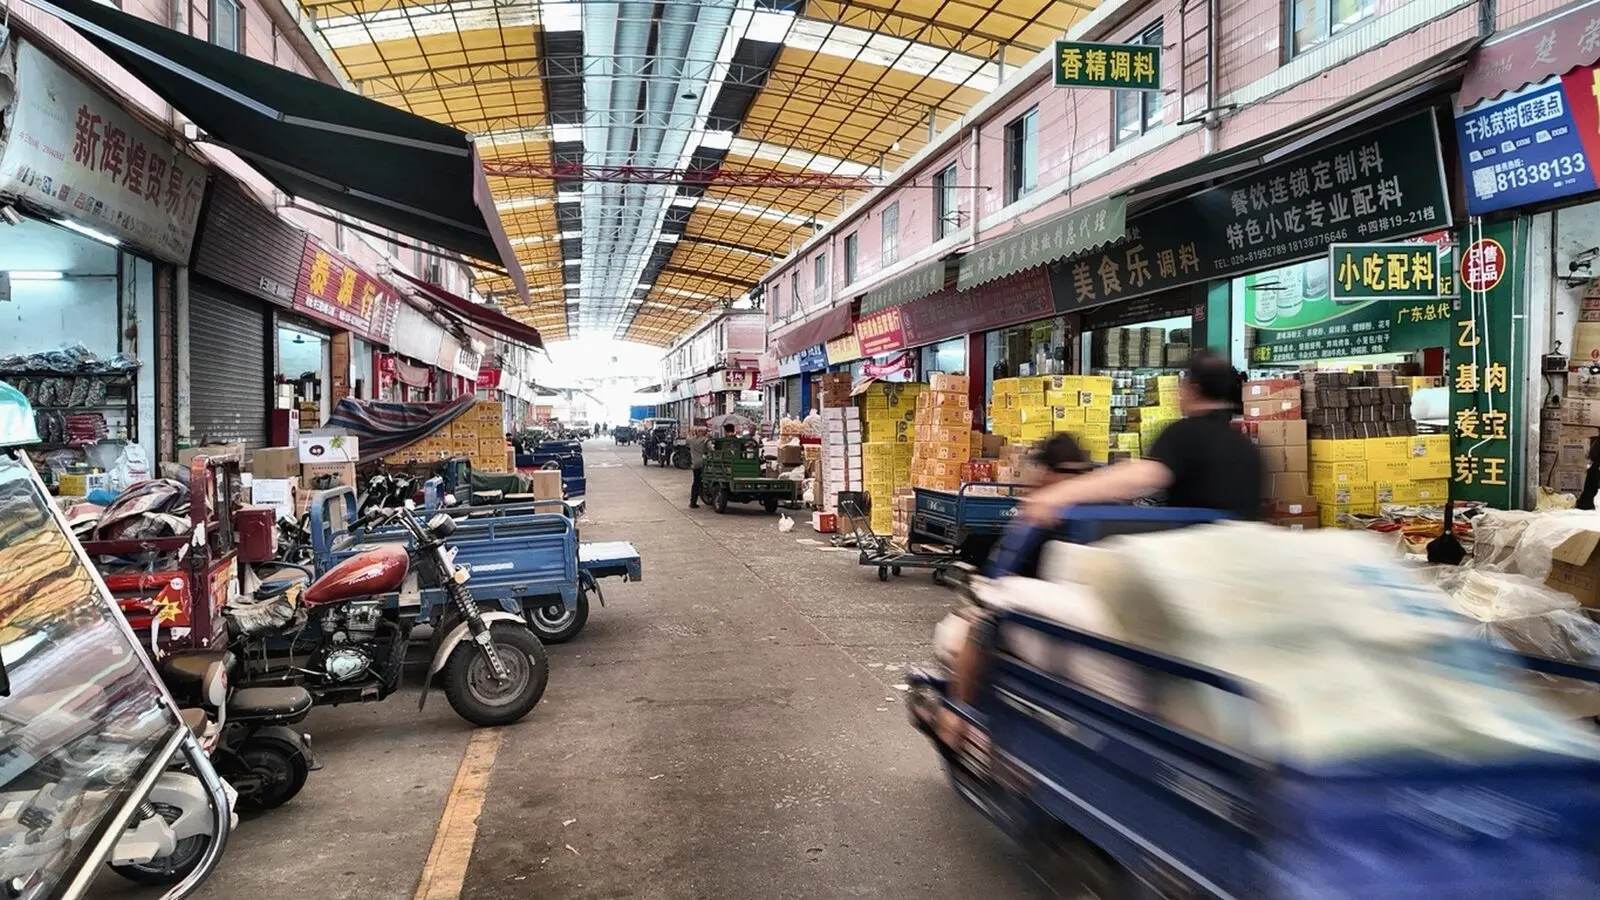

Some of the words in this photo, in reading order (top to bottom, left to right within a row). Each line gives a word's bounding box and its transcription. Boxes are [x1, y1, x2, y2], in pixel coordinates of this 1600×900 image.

[1061, 47, 1155, 83] 香精调料
[1465, 94, 1561, 142] 千兆宽带报装点
[72, 104, 201, 226] 新辉煌贸易行
[1231, 141, 1384, 217] 餐饮连锁定制料
[1497, 153, 1585, 192] 81338133
[1226, 175, 1403, 250] 特色小吃专业配料
[1288, 228, 1348, 252] 18138776646
[1357, 205, 1436, 236] 中四排19-21档
[1072, 244, 1152, 304] 美食乐
[1157, 241, 1200, 279] 调料
[1338, 251, 1434, 291] 小吃配料
[1397, 303, 1451, 324] 广东总代
[1481, 362, 1507, 486] 肉宝王
